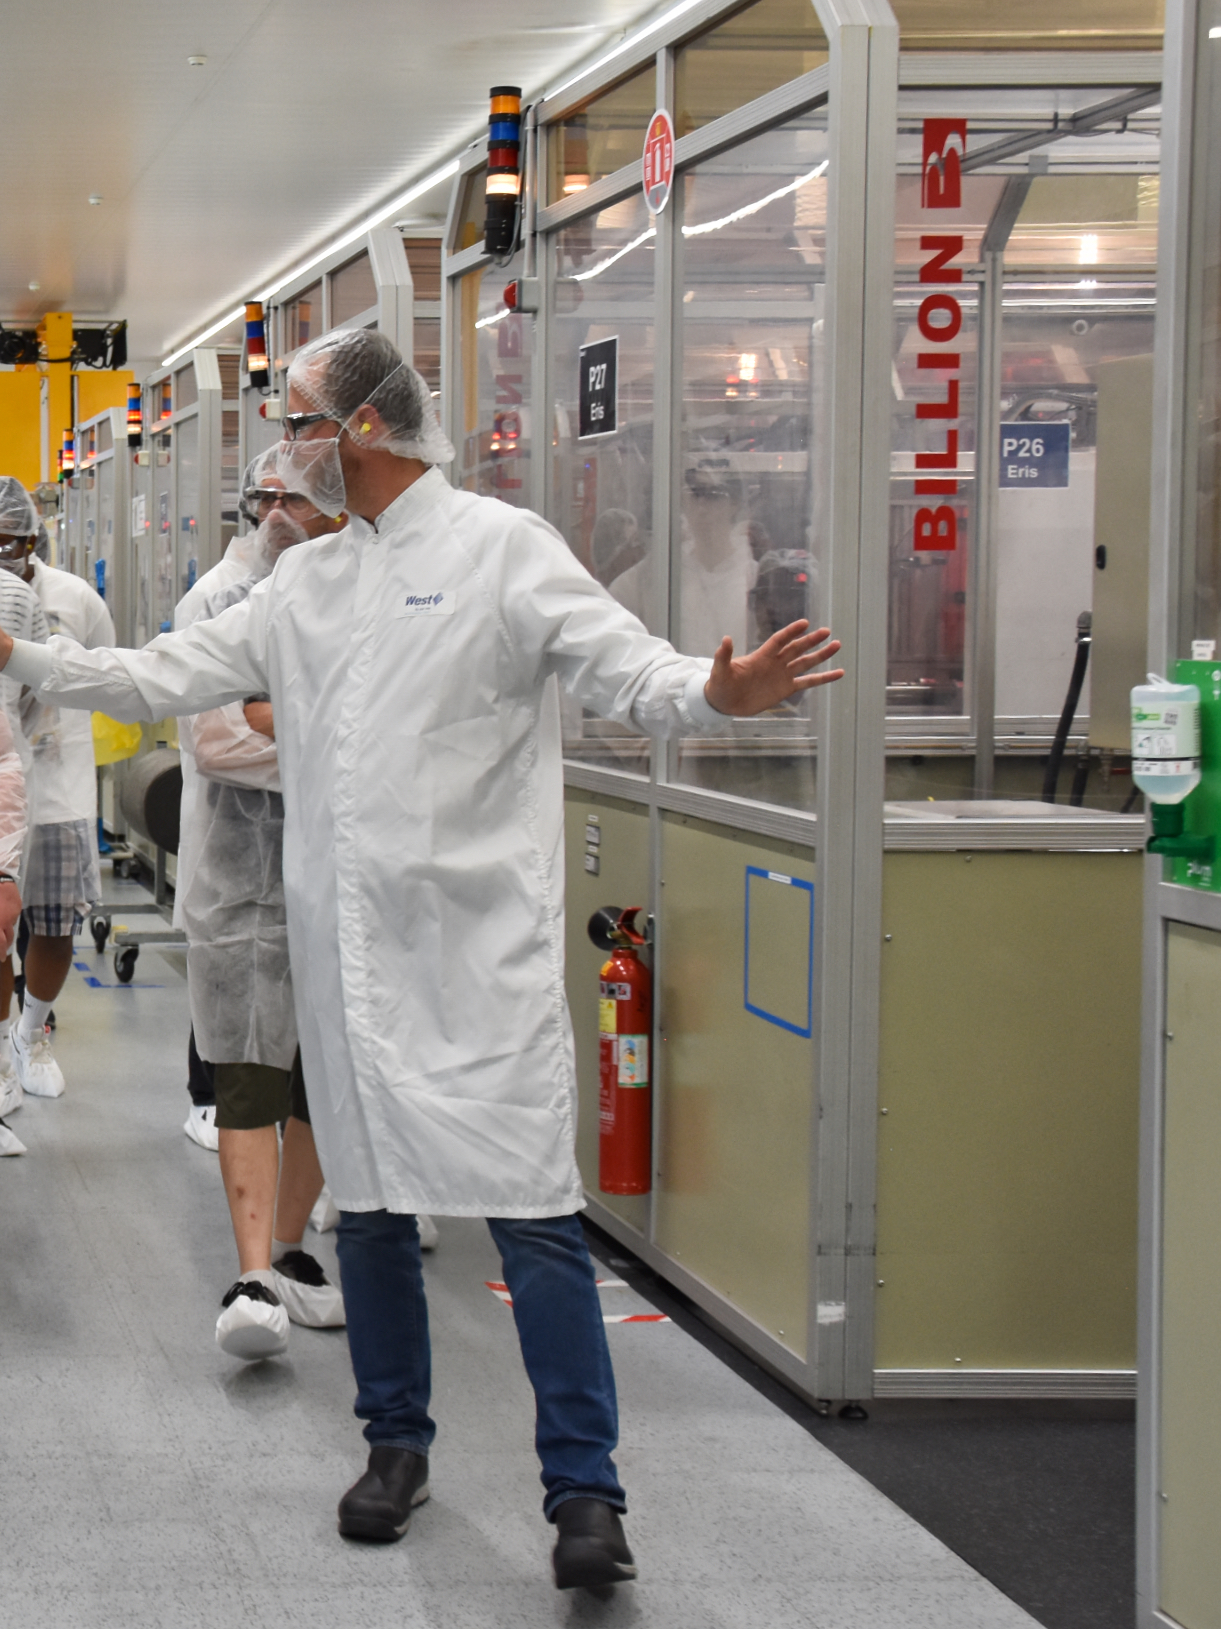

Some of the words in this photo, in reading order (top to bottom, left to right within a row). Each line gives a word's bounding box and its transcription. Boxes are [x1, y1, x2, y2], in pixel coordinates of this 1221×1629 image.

[589, 363, 607, 392] P27
[914, 235, 963, 551] BILLION
[590, 402, 605, 421] Eris
[1003, 438, 1045, 457] P26
[1007, 465, 1039, 478] Eris
[405, 595, 433, 606] West
